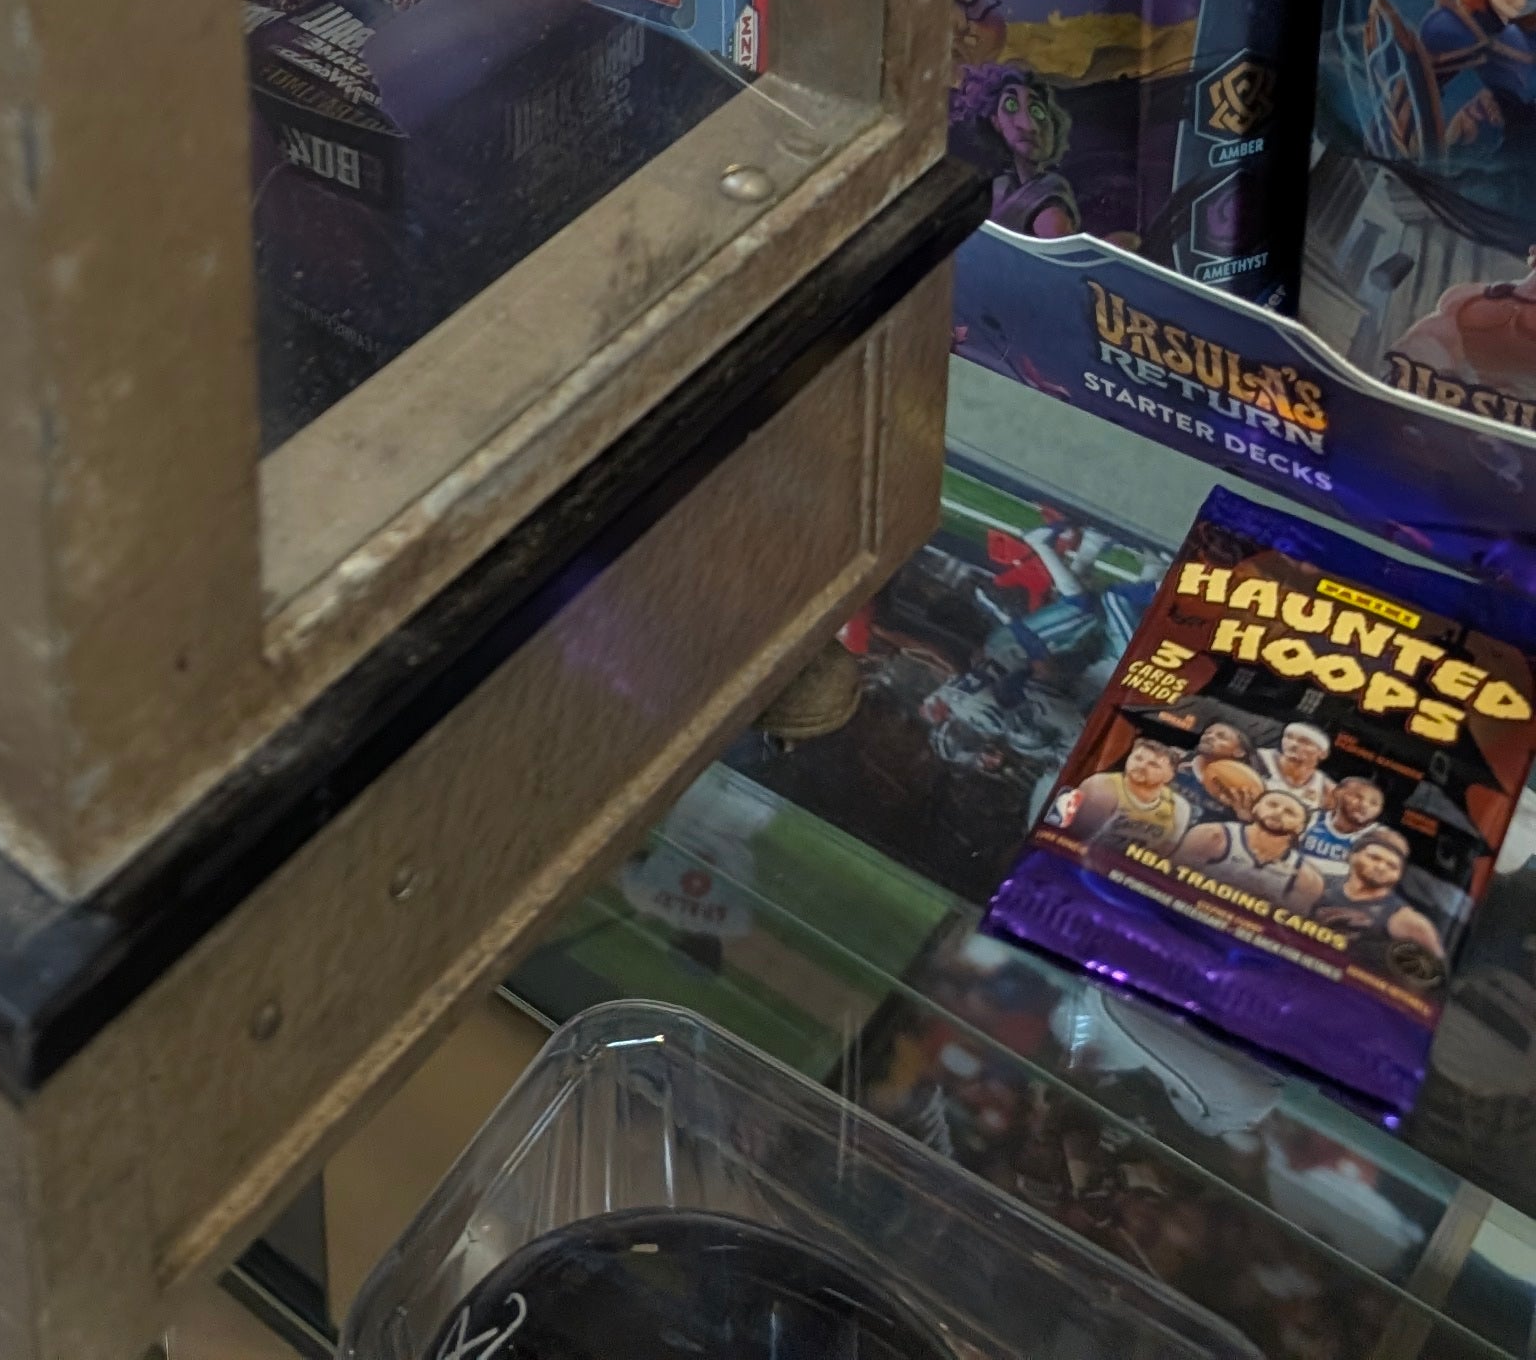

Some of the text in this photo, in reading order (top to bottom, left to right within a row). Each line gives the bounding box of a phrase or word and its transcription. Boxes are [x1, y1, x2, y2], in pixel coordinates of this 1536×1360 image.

[1218, 138, 1264, 161] AMBER
[1202, 252, 1268, 280] AMETHYST
[1087, 280, 1327, 431] URSULA'S
[1084, 371, 1333, 492] STARTER DECKS
[1099, 341, 1324, 454] RETURN
[1177, 563, 1533, 720] HAUNTED
[1319, 581, 1419, 627] PANINI
[1121, 673, 1180, 705] INSIDE
[1128, 661, 1188, 692] CARDS
[1151, 640, 1195, 669] 3
[1210, 619, 1465, 743] HOOPS
[1125, 843, 1173, 875] NBA
[1176, 865, 1271, 918] TRADING
[1273, 908, 1349, 951] CARDS
